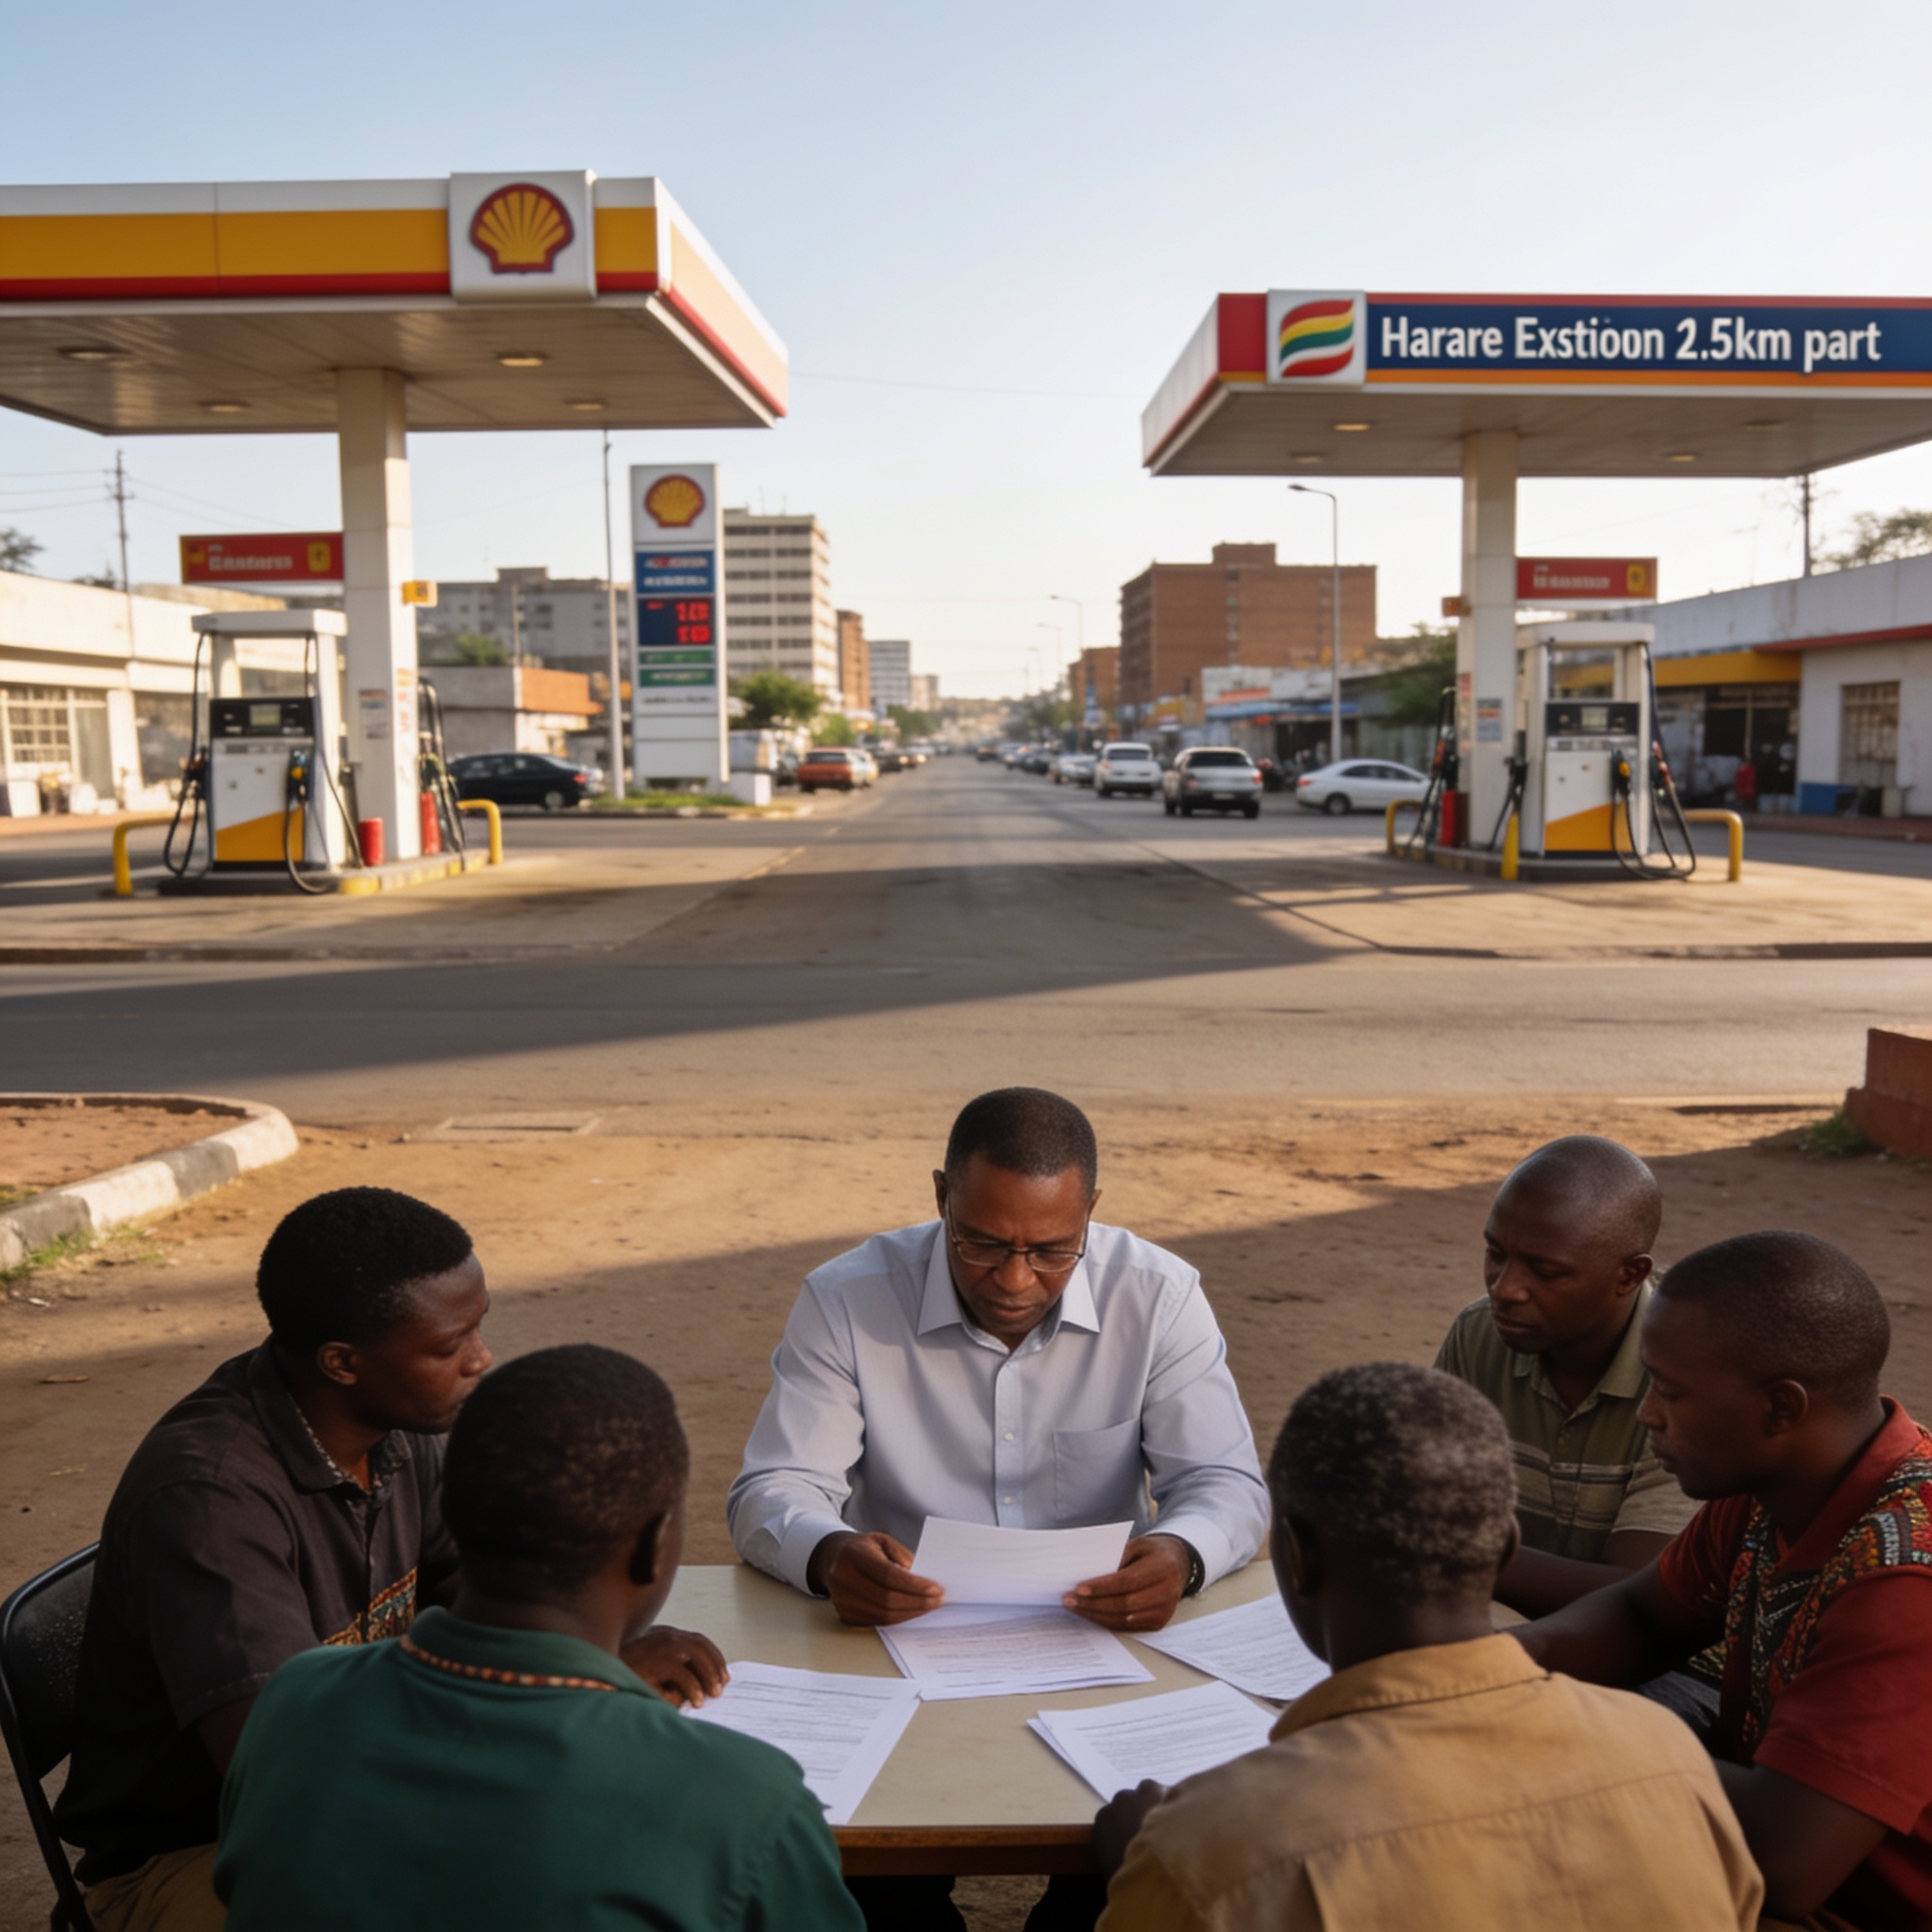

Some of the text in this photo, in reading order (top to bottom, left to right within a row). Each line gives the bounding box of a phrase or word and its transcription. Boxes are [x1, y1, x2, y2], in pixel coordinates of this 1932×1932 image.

[1381, 316, 1504, 358] Harare
[1675, 316, 1791, 359] 2.5km
[1804, 322, 1882, 373] part
